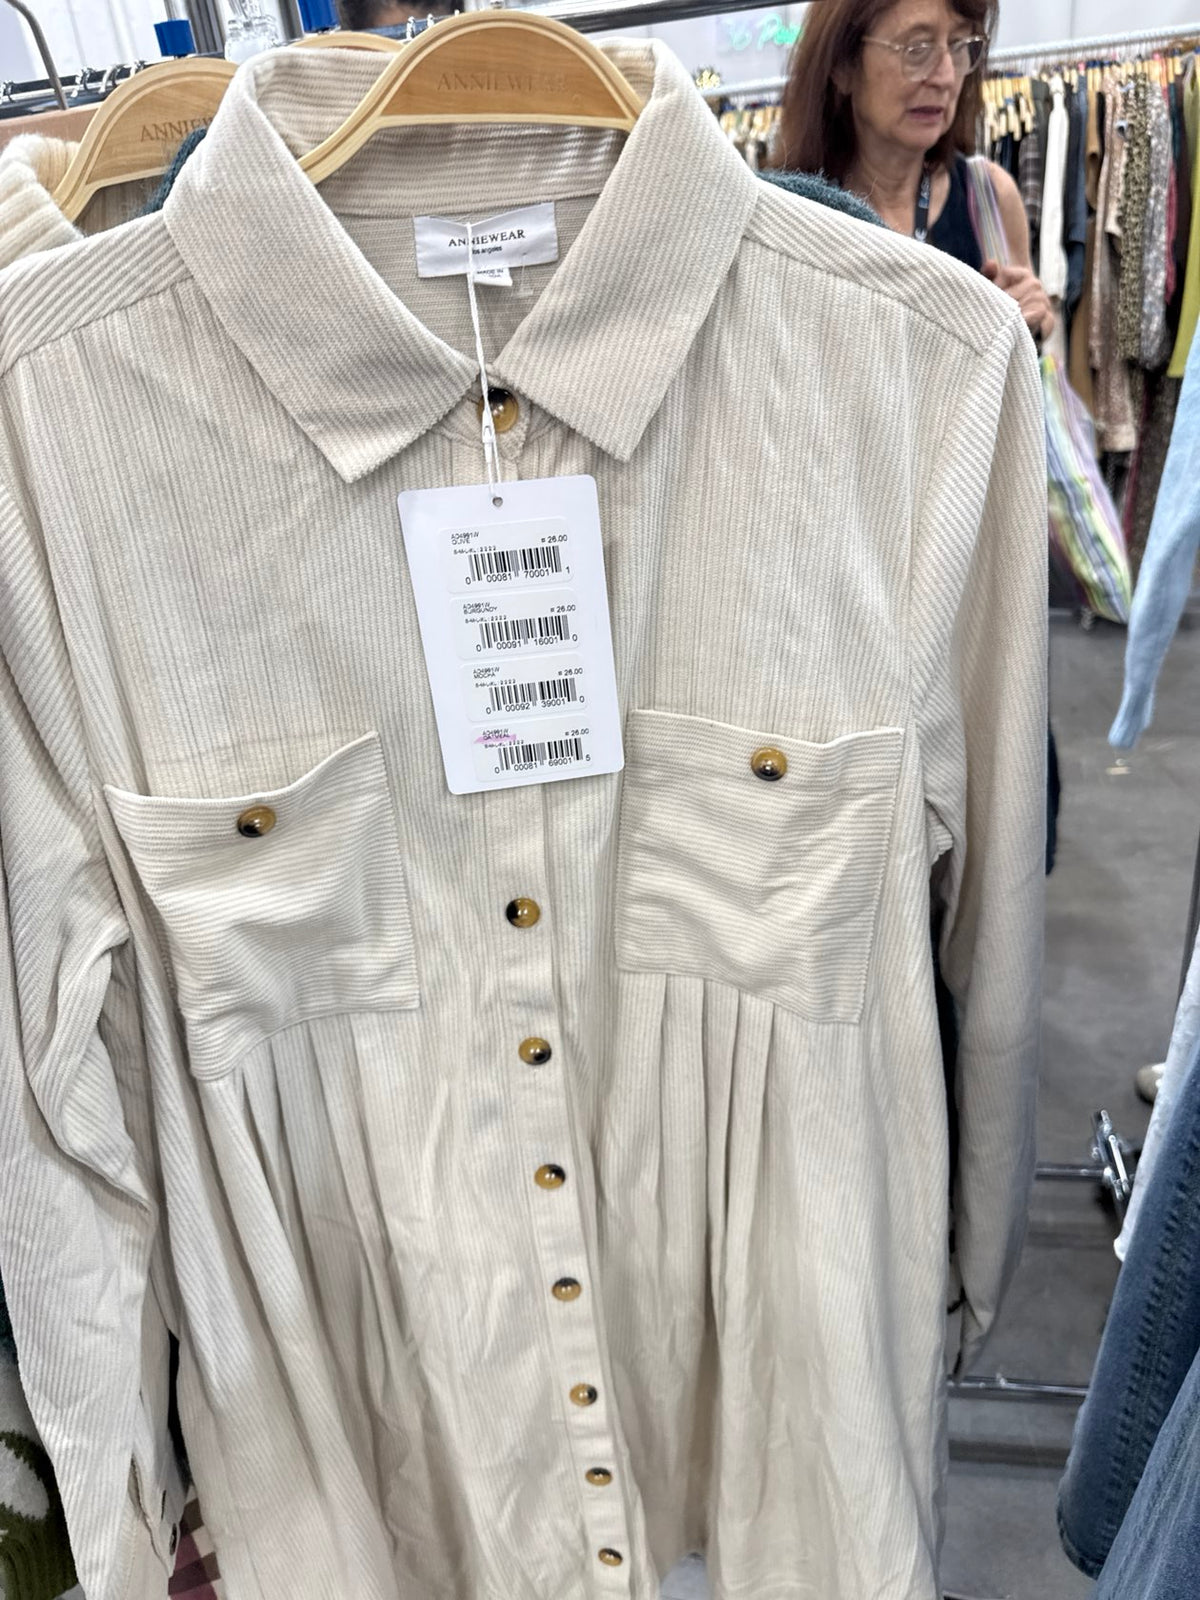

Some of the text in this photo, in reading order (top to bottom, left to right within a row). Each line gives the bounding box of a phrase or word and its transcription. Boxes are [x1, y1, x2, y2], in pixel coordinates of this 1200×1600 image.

[548, 535, 568, 543] 26.00
[465, 566, 570, 585] 0 00081 70001 1
[557, 604, 576, 613] 26.00
[476, 644, 481, 652] 0
[497, 641, 521, 650] 00091
[534, 636, 559, 646] 16001
[564, 667, 583, 676] 26.00
[505, 702, 530, 712] 00092
[541, 698, 566, 708] 39001
[571, 728, 589, 736] 26.00
[514, 762, 538, 771] 00081
[548, 757, 572, 767] 69001
